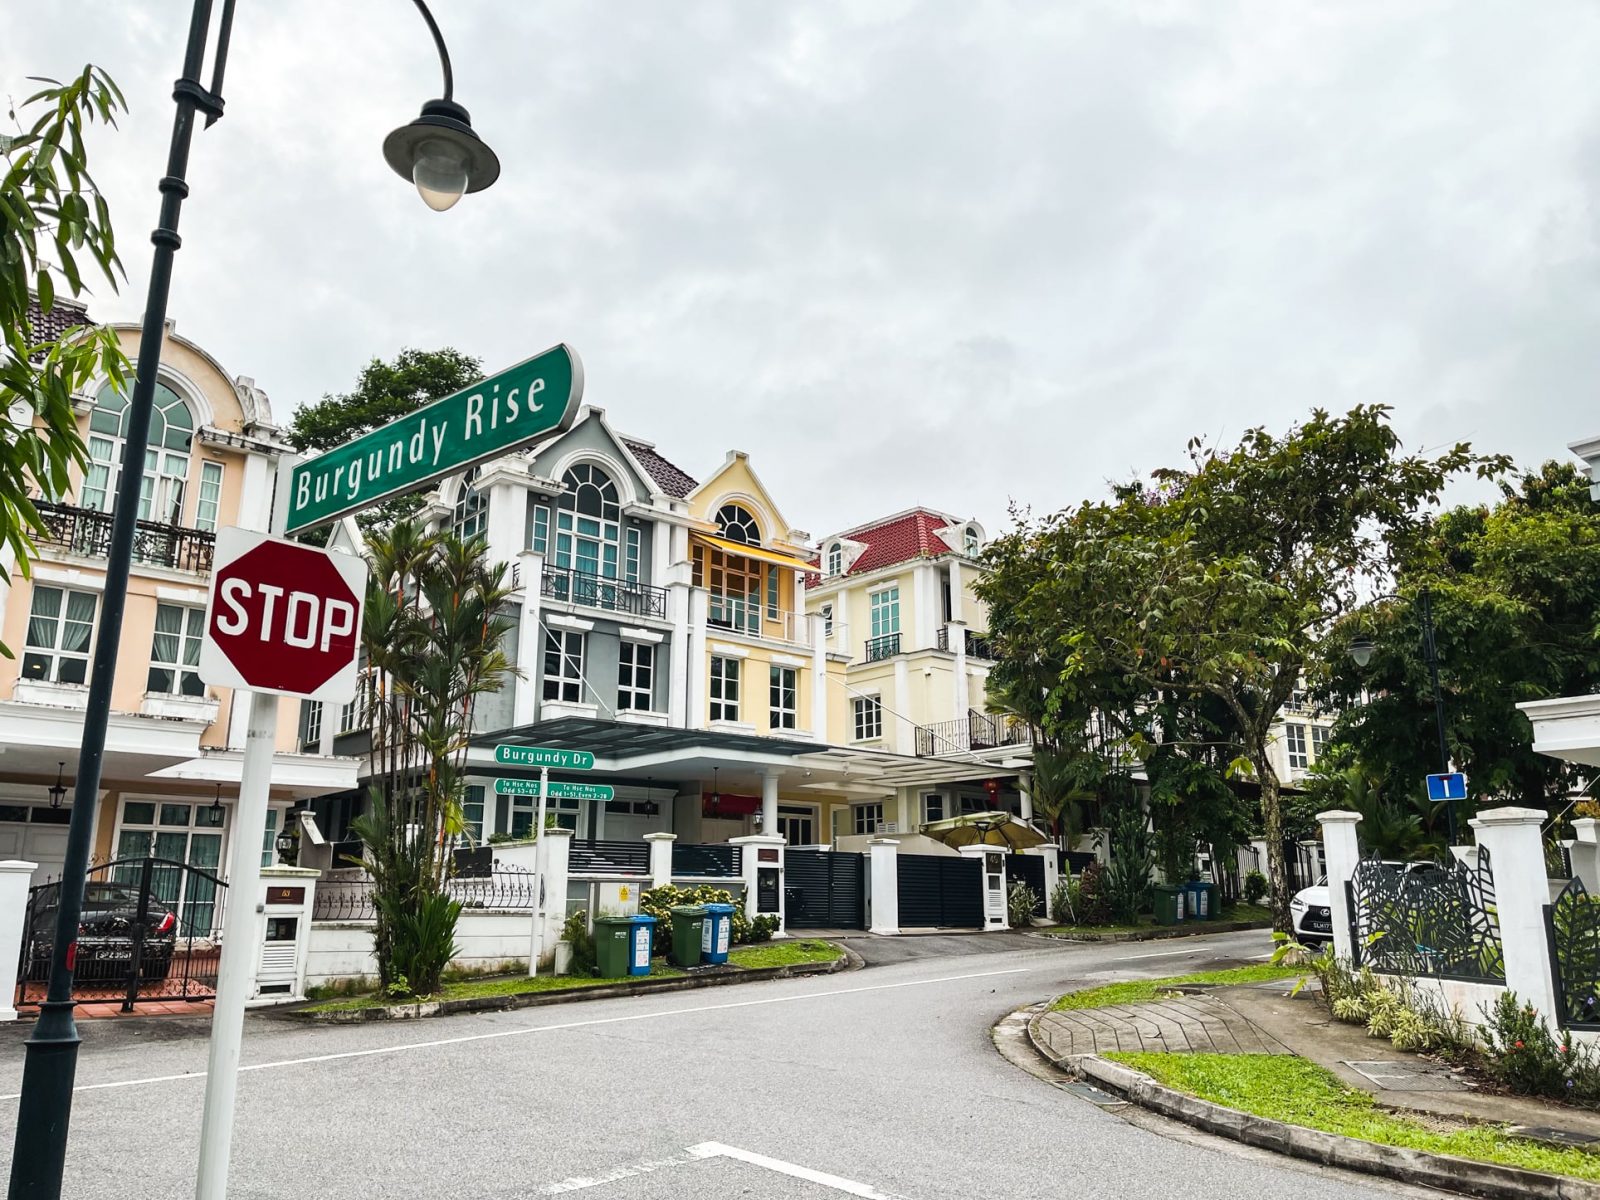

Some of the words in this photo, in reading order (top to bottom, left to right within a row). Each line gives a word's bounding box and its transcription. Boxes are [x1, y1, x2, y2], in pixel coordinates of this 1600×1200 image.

[296, 418, 448, 512] Burgundy
[464, 377, 546, 441] Rise
[216, 577, 355, 653] STOP
[503, 747, 568, 766] Burgundy
[573, 753, 588, 765] Dr
